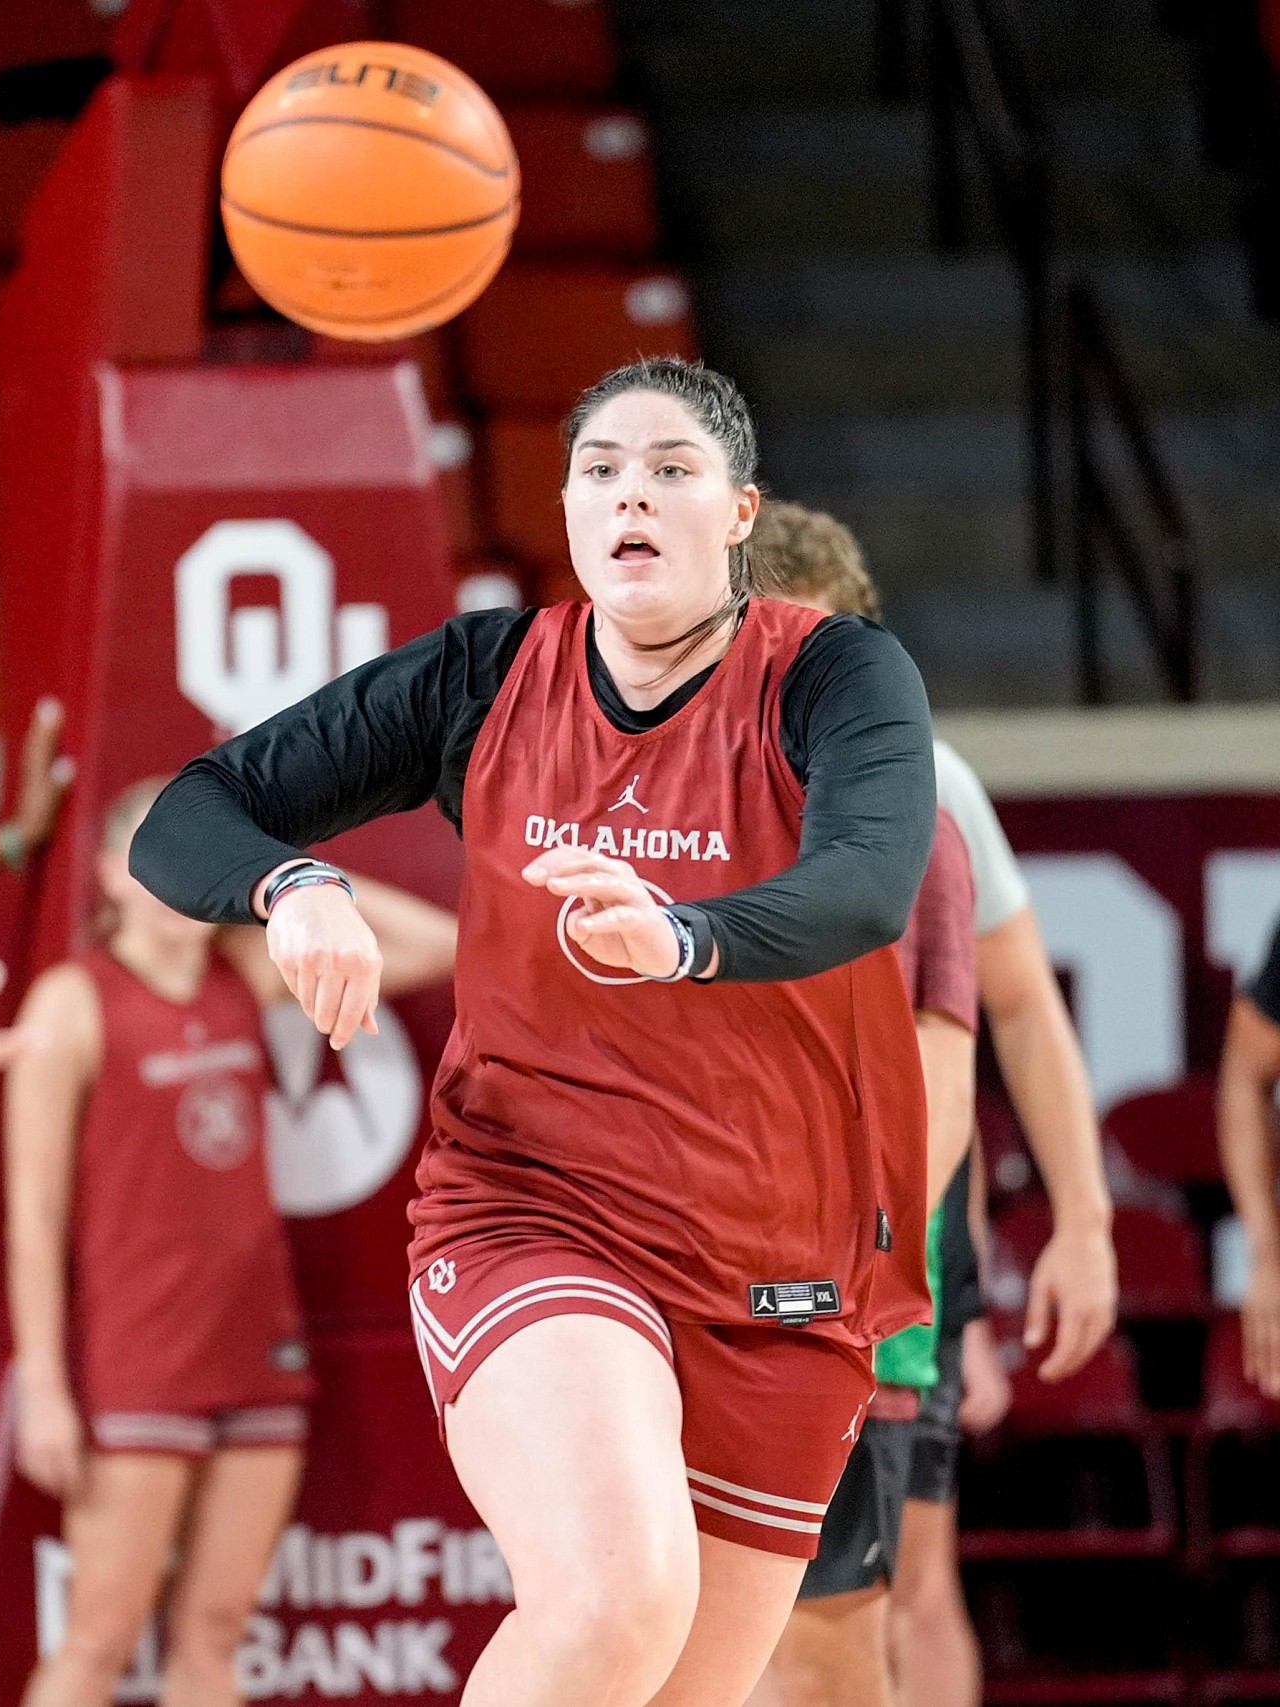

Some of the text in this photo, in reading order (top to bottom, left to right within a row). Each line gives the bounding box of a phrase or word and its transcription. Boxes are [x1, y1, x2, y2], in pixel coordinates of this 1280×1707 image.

[524, 814, 730, 861] OKLAHOMA
[815, 1290, 834, 1303] XXL
[259, 1518, 517, 1607] MIDFIR
[233, 1614, 457, 1697] BANK
